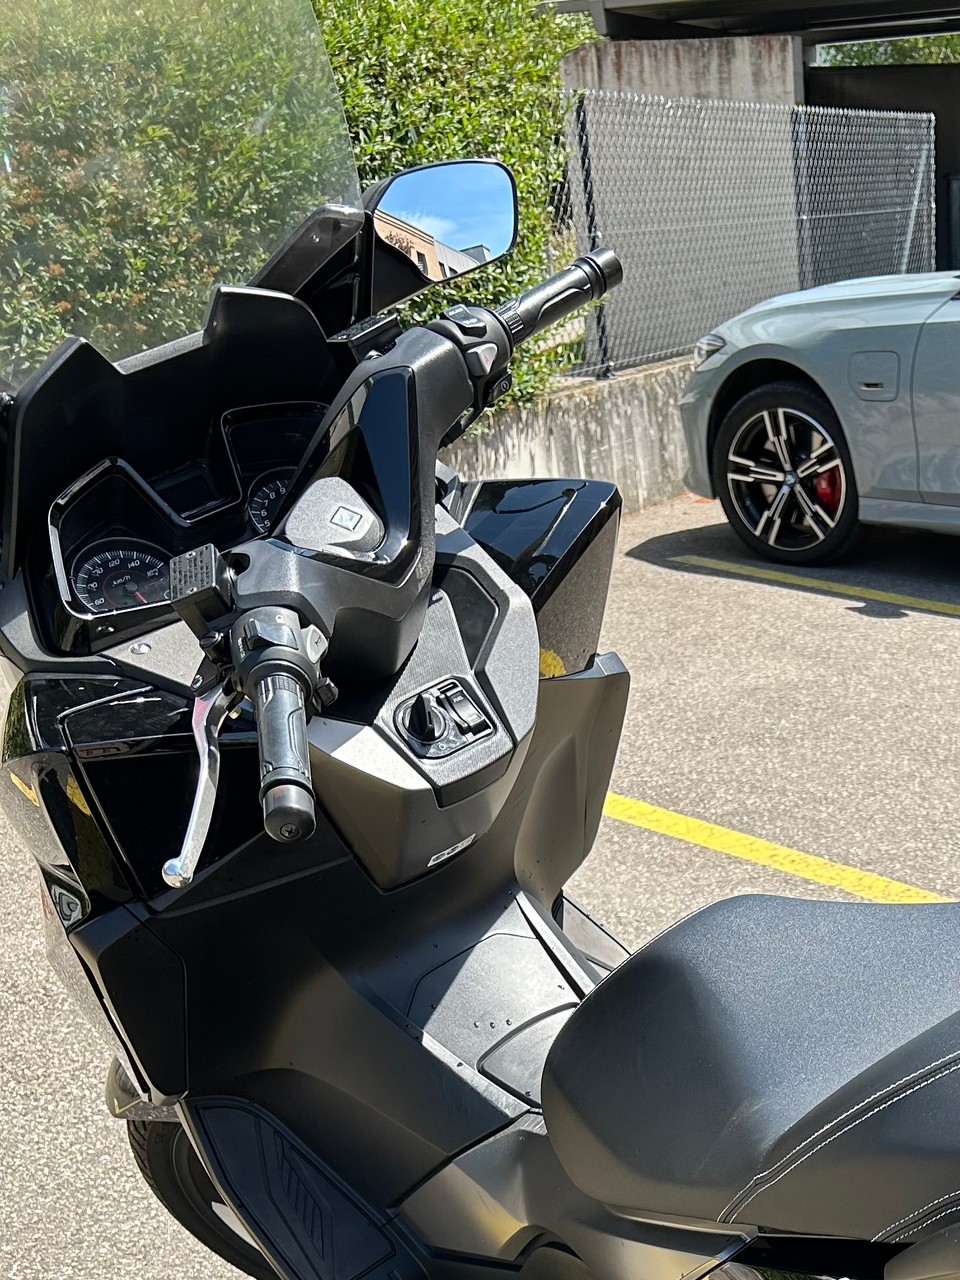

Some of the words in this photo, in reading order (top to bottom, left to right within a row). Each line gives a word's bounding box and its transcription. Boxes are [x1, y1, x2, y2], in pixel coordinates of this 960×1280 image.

[279, 487, 286, 495] 9
[261, 509, 267, 517] 6
[264, 519, 271, 527] 5
[127, 559, 141, 569] 140
